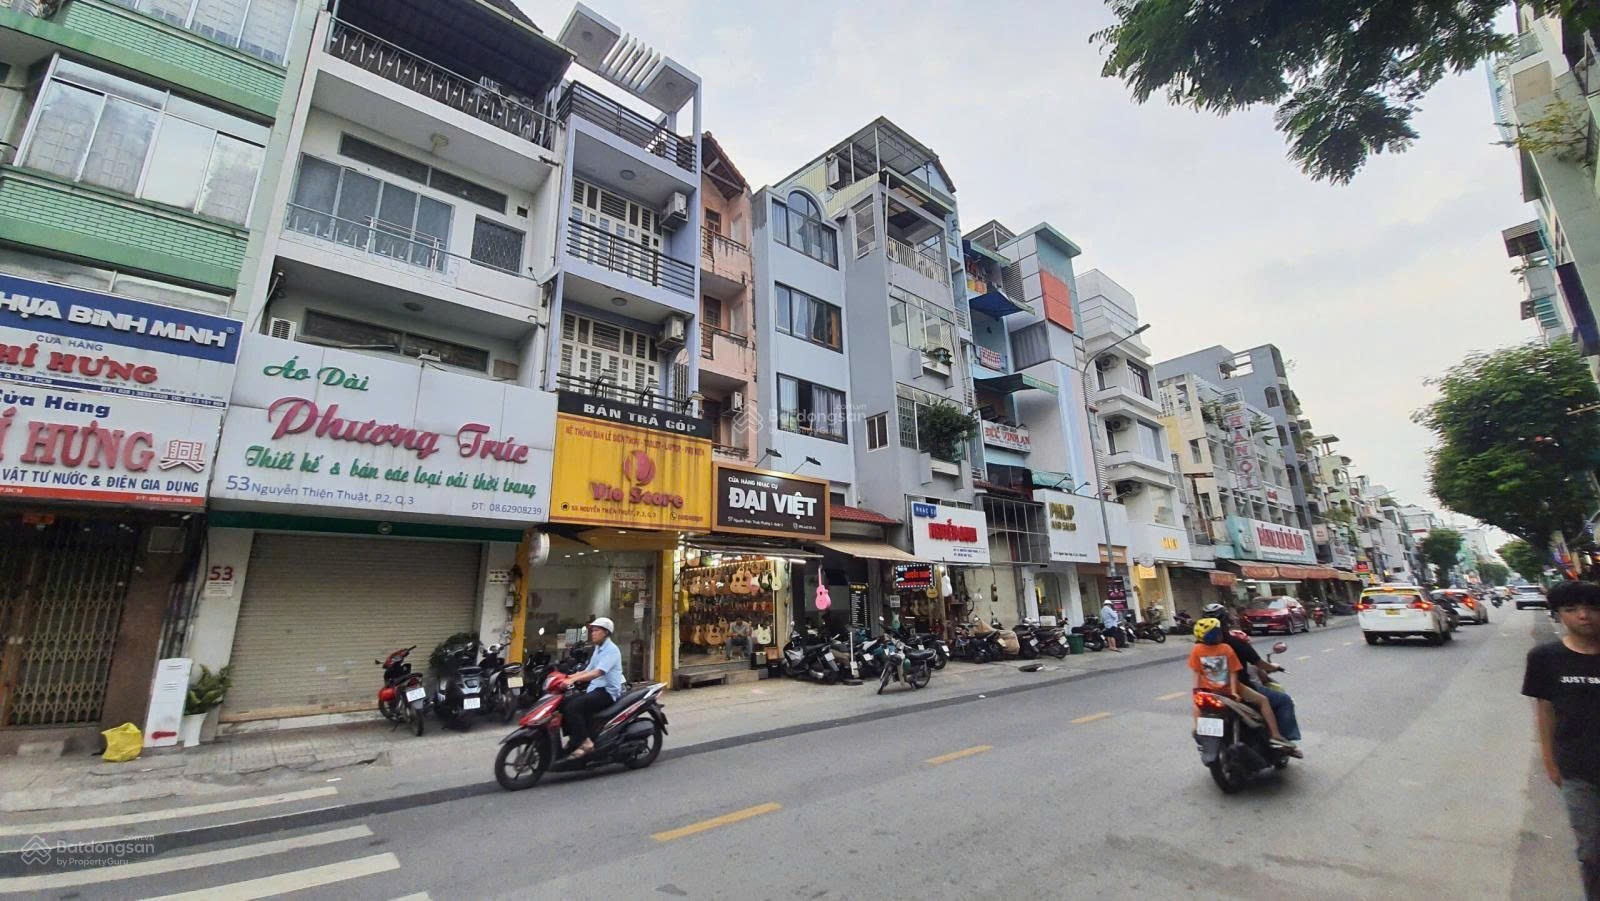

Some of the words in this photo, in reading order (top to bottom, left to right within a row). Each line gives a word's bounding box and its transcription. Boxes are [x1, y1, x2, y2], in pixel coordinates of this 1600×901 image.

[47, 351, 159, 385] HƯNG
[263, 356, 311, 383] Áo
[317, 366, 369, 392] Dài
[44, 394, 111, 419] Hàng
[583, 403, 622, 420] BÁN
[628, 412, 659, 427] TRẢ
[665, 416, 697, 433] GÓP
[20, 420, 156, 473] HƯNG
[267, 396, 440, 460] Phương
[457, 423, 529, 464] Trúc
[157, 440, 205, 473] 興
[245, 445, 293, 471] Thiết
[330, 462, 341, 476] &
[503, 479, 537, 500] trang
[91, 475, 101, 487] &
[141, 478, 160, 491] GIA
[226, 474, 251, 492] 53
[251, 480, 299, 501] Nguyễn
[302, 485, 334, 500] Thiện
[336, 487, 373, 504] Thuật,
[728, 486, 767, 515] ĐẠI
[772, 491, 818, 520] VIỆT
[209, 566, 233, 581] 53
[1560, 676, 1586, 684] JUST
